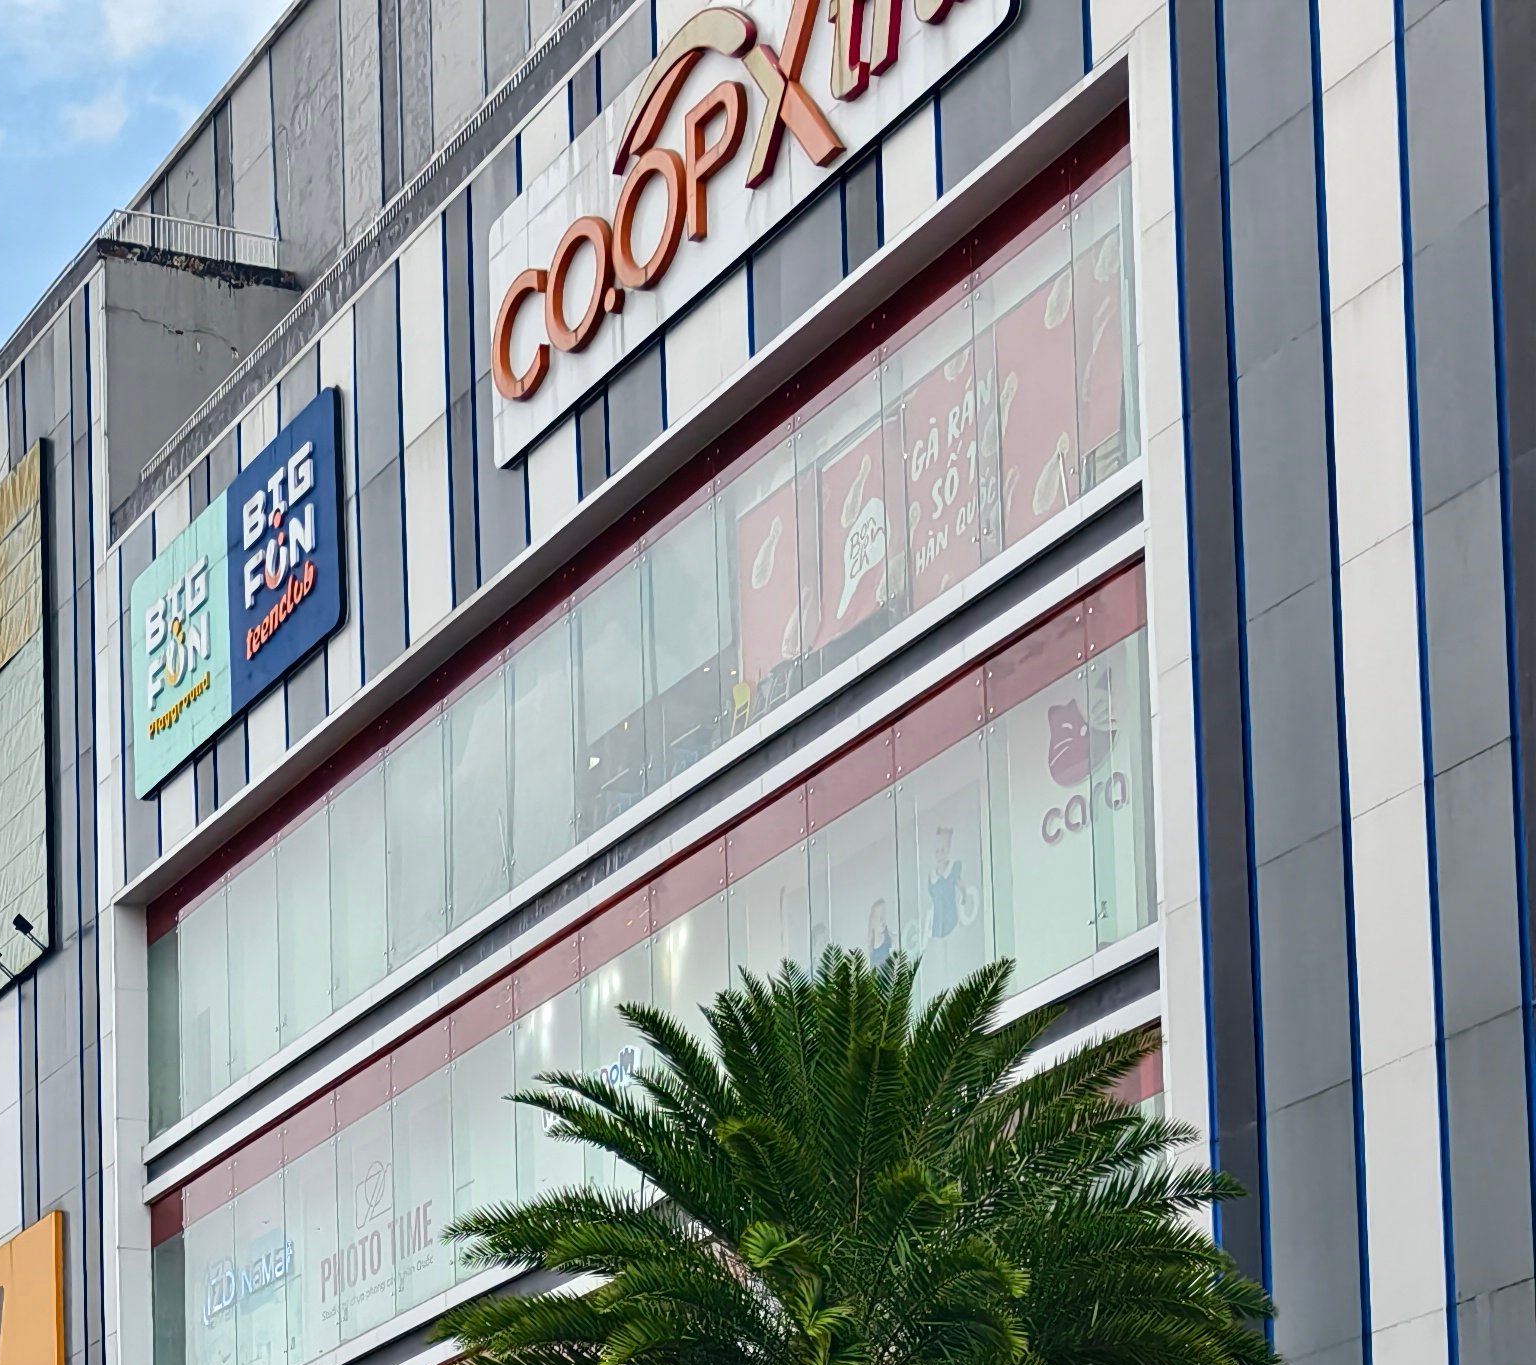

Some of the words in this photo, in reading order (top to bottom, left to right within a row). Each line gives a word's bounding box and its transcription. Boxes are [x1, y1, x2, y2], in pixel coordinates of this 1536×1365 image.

[242, 440, 314, 552] BIG
[145, 555, 210, 656] BIG
[244, 502, 316, 611] FUN
[147, 611, 211, 711] FUN
[245, 561, 317, 661] teenclub
[148, 671, 211, 741] Playground
[321, 1231, 382, 1303] PHOTO
[387, 1200, 434, 1265] TIME
